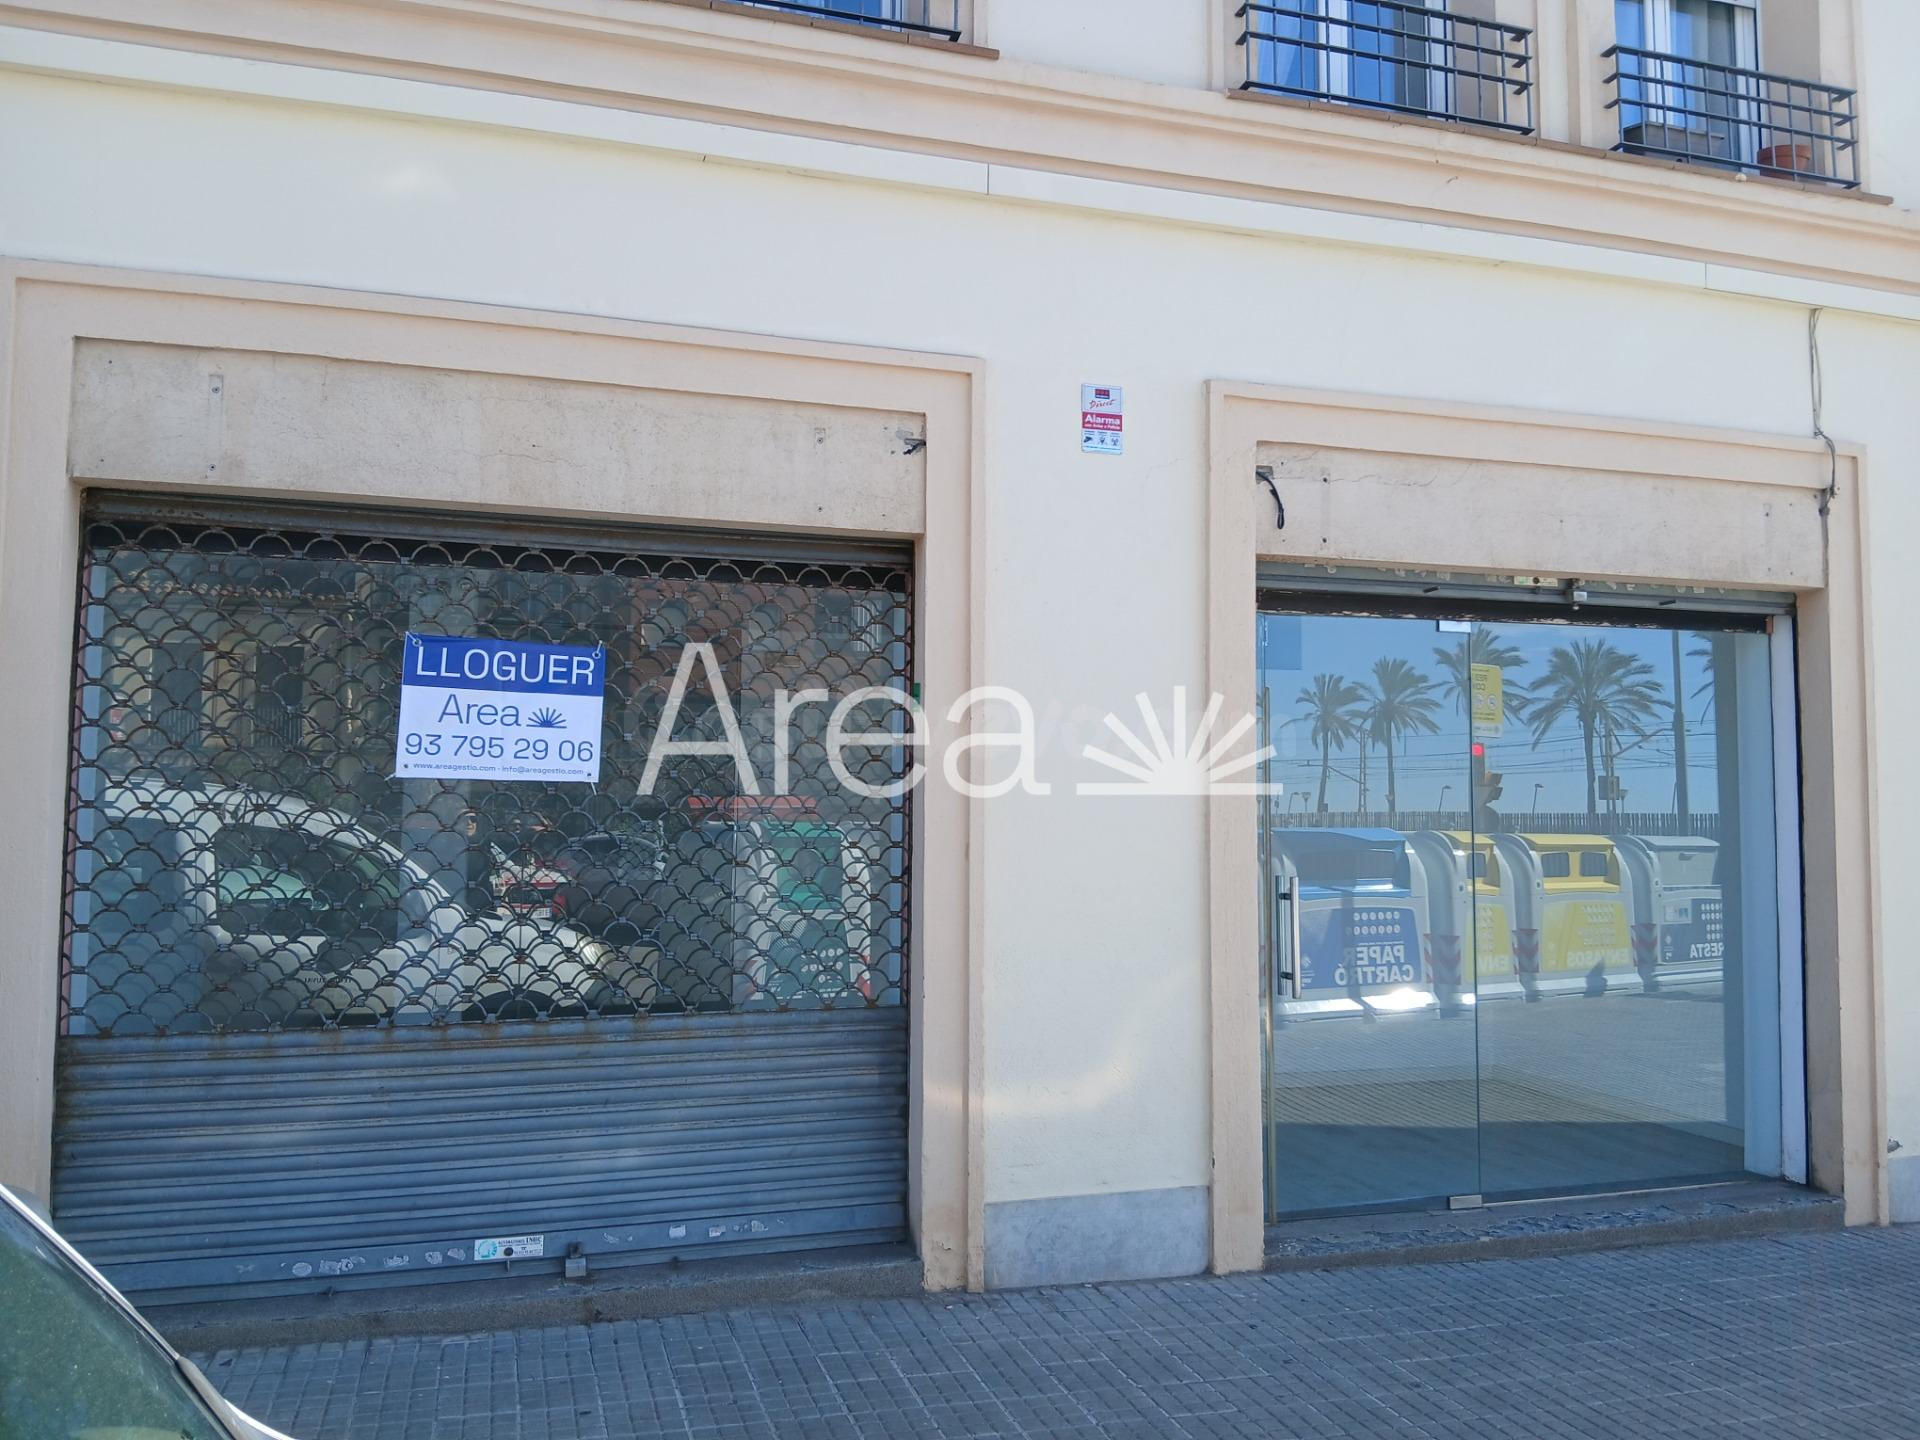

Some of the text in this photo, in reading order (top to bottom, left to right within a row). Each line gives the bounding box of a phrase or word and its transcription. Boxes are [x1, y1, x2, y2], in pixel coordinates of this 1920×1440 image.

[1085, 414, 1120, 425] Alarma
[416, 646, 595, 686] LLOGUER
[438, 694, 521, 727] Area
[405, 733, 594, 762] 93 795 29 06
